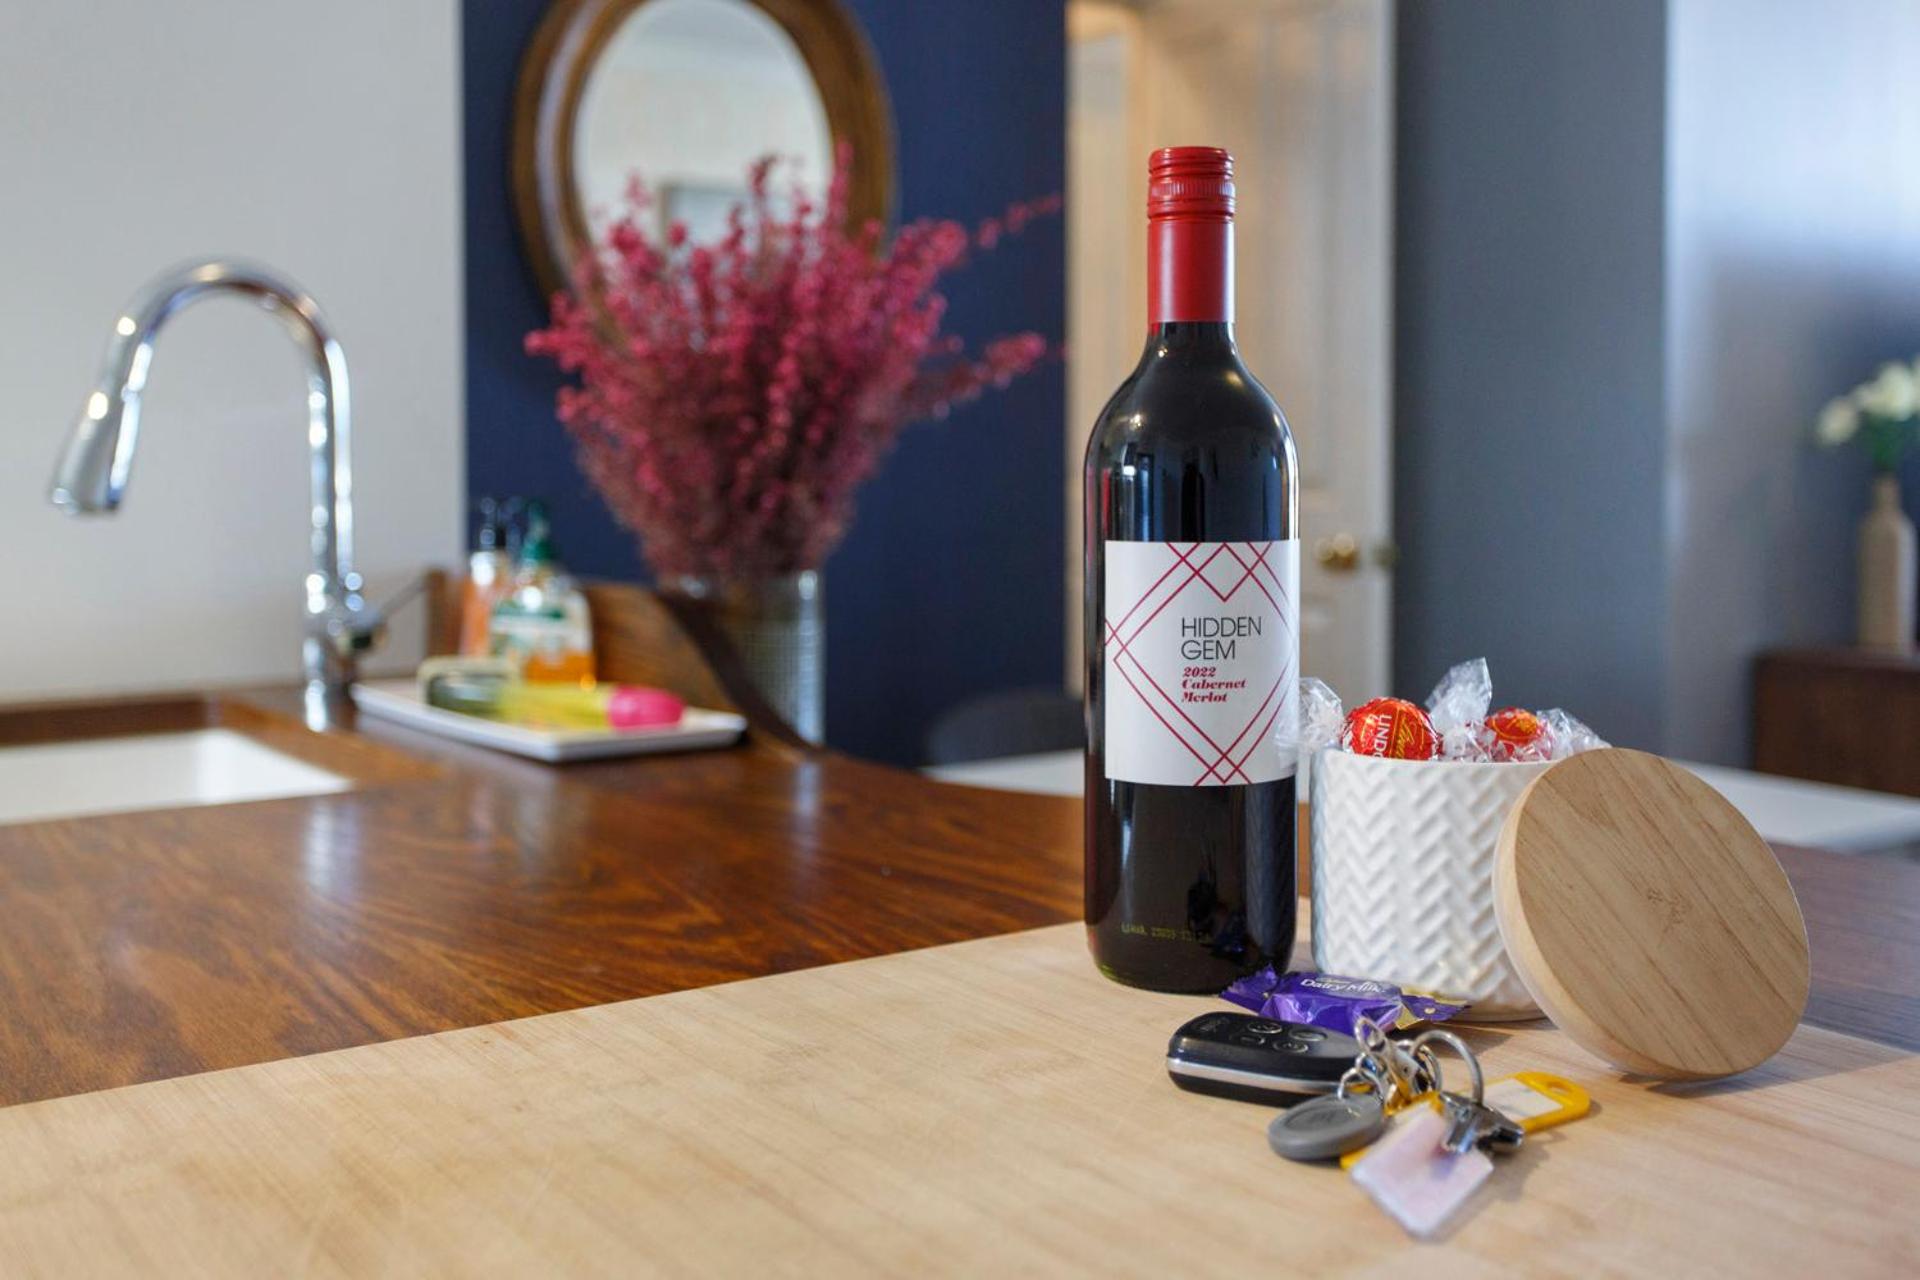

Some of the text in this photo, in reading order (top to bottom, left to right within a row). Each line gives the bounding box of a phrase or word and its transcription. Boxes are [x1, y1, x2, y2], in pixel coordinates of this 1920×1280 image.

[1181, 616, 1262, 638] HIDDEN
[1181, 640, 1236, 660] GEM
[1183, 666, 1217, 678] 2022
[1182, 679, 1246, 689] Cabernet
[1182, 691, 1228, 702] Merlot
[1301, 979, 1346, 991] Dairy
[1347, 981, 1381, 993] Milk
